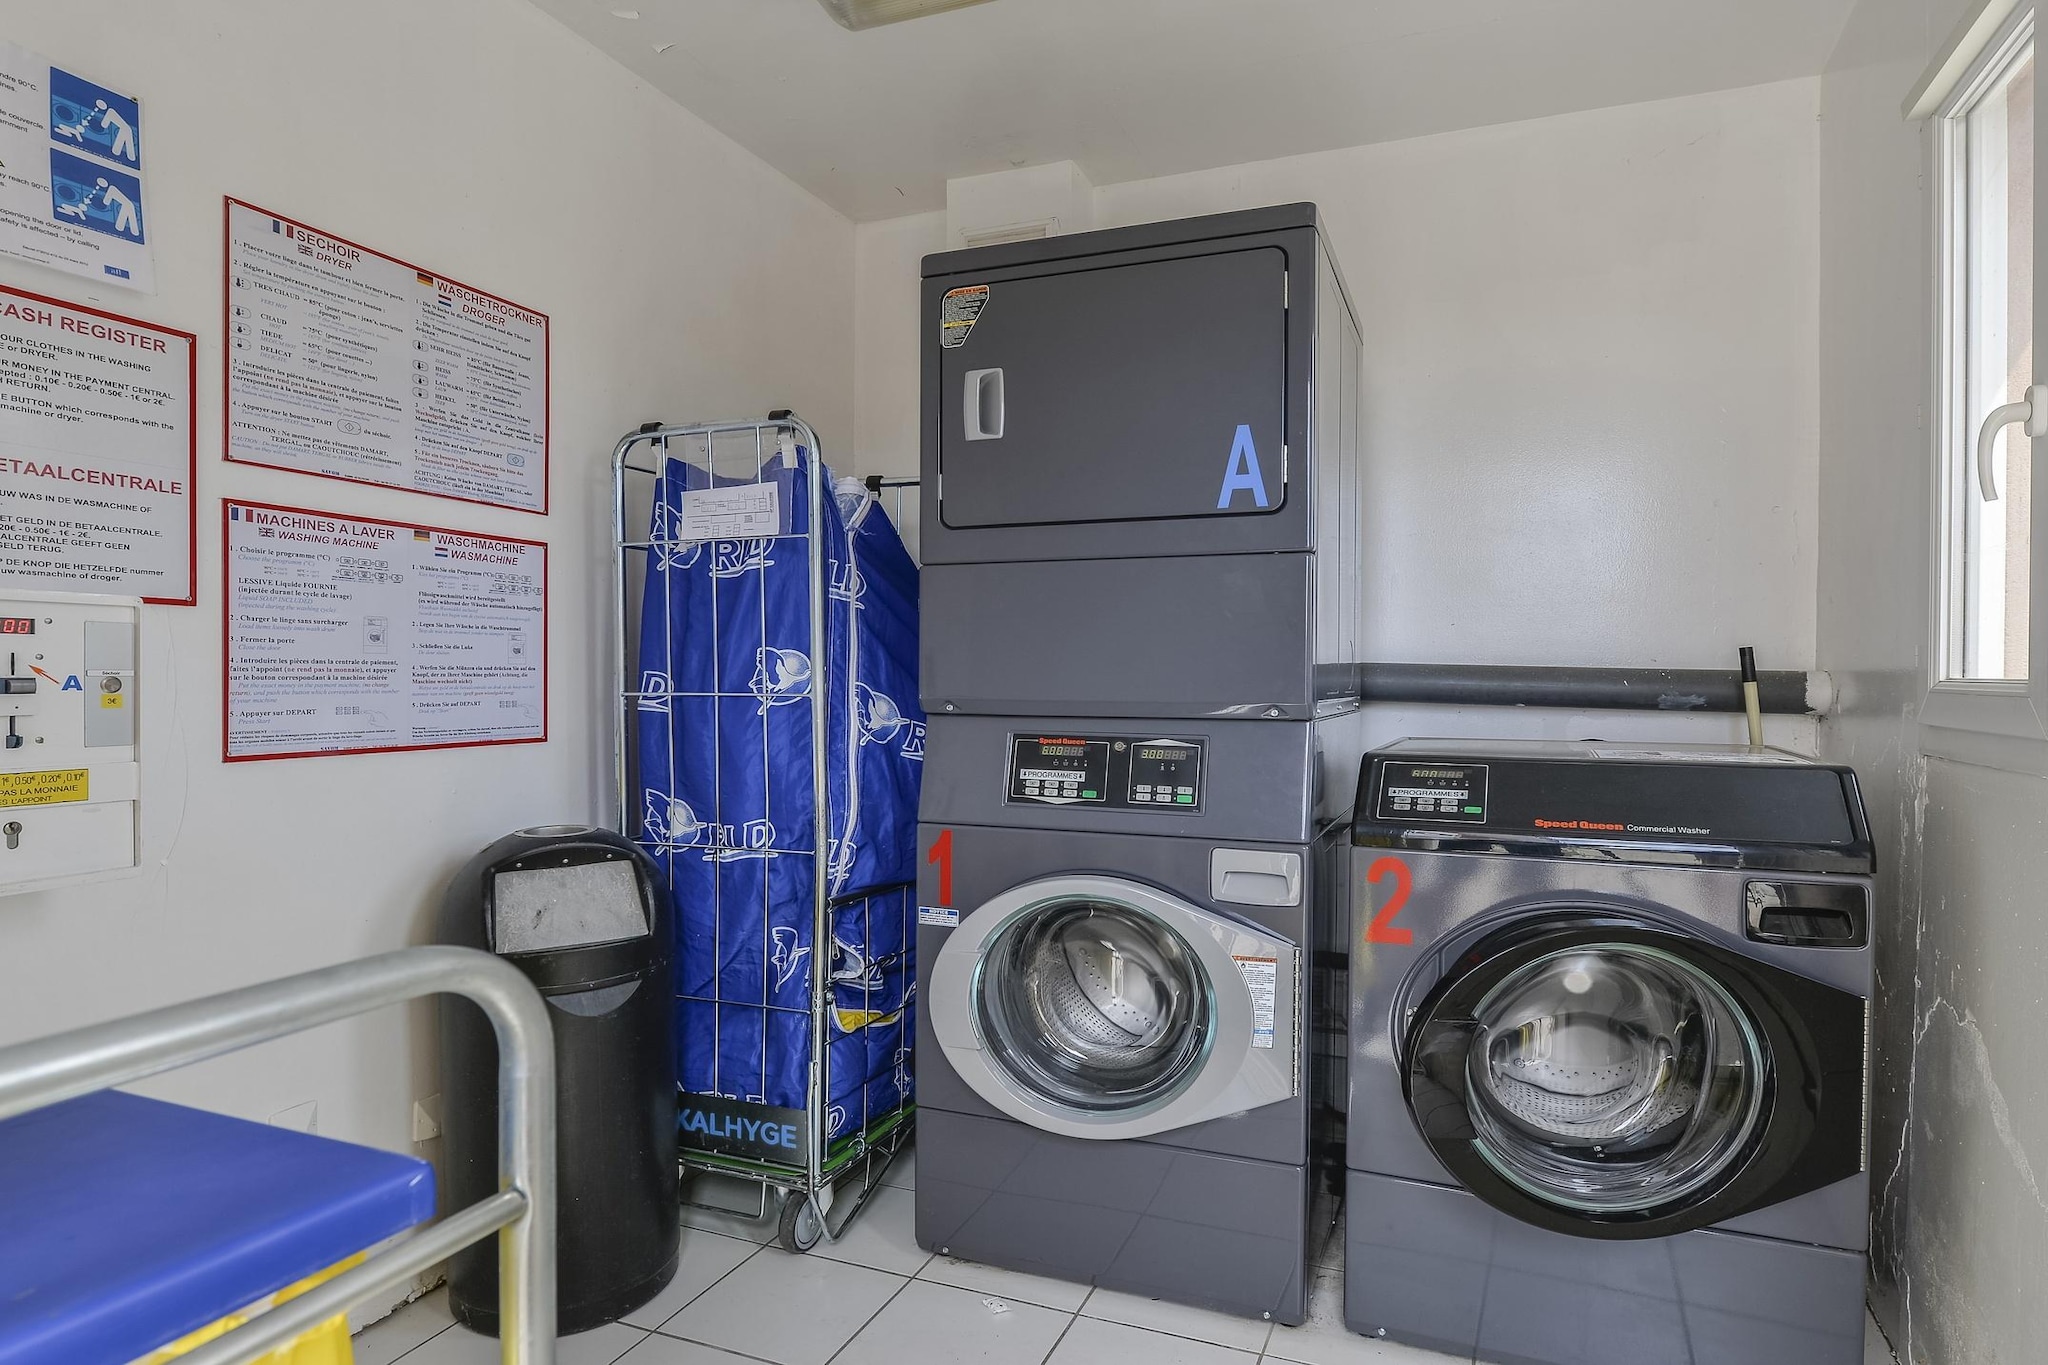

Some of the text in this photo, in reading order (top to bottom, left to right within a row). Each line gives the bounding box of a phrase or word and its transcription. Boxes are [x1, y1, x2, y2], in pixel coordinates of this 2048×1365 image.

[32, 217, 44, 225] the
[45, 221, 62, 230] door
[29, 224, 59, 238] affected
[77, 238, 100, 251] calling
[297, 230, 360, 262] SECHOIR
[316, 252, 352, 272] DRYER
[260, 313, 287, 326] CHAUD
[462, 304, 506, 326] DROGER
[60, 316, 167, 354] REGISTER
[21, 347, 58, 361] DRYER.
[26, 340, 72, 355] CLOTHES
[76, 350, 84, 358] IN
[88, 352, 106, 363] THE
[108, 357, 151, 372] WASHING
[6, 378, 50, 392] RETURN.
[12, 361, 48, 374] MONEY
[64, 372, 82, 382] THE
[86, 376, 130, 391] PAYMENT
[132, 386, 176, 400] CENTRAL.
[35, 374, 60, 386] 0.10€
[68, 382, 92, 392] 0.20€
[100, 388, 122, 398] 0.50€
[130, 394, 140, 402] 1€
[0, 404, 42, 415] machine
[57, 412, 84, 423] dryer.
[11, 395, 52, 408] BUTTON
[55, 404, 82, 414] which
[84, 409, 139, 424] corresponds
[142, 418, 159, 428] with
[1216, 424, 1269, 509] A
[19, 492, 42, 500] WAS
[74, 498, 138, 512] WASMACHINE
[16, 517, 44, 525] GELD
[75, 522, 163, 538] BETAALCENTRALE.
[256, 513, 396, 540] MACHINES A LAVER
[27, 544, 64, 553] TERUG.
[71, 539, 102, 548] GEEFT
[104, 542, 130, 551] GEEN
[278, 530, 380, 550] WASHING MACHINE
[437, 534, 526, 555] WASCHMACHINE
[240, 546, 266, 555] Choisir
[276, 550, 316, 560] programme
[451, 550, 518, 566] WASMACHINE
[6, 558, 164, 576] DE KNOP DIE HETZELFDE nummer
[18, 570, 76, 578] wasmachine
[90, 573, 122, 582] droger.
[239, 578, 338, 590] LESSIVE Liquide FOURNIE
[303, 590, 320, 599] cycle
[240, 614, 270, 624] Charger
[61, 674, 83, 691] A
[240, 710, 270, 718] Appuyer
[286, 708, 317, 716] DEPART
[1028, 770, 1078, 780] PROGRAMMES
[20, 788, 32, 796] LA
[34, 785, 78, 794] MONNAIE
[1397, 789, 1459, 798] PROGRAMMES
[1534, 818, 1710, 835] Speed Queen Commercial Washer
[928, 829, 952, 906] 1
[1365, 856, 1413, 945] 2
